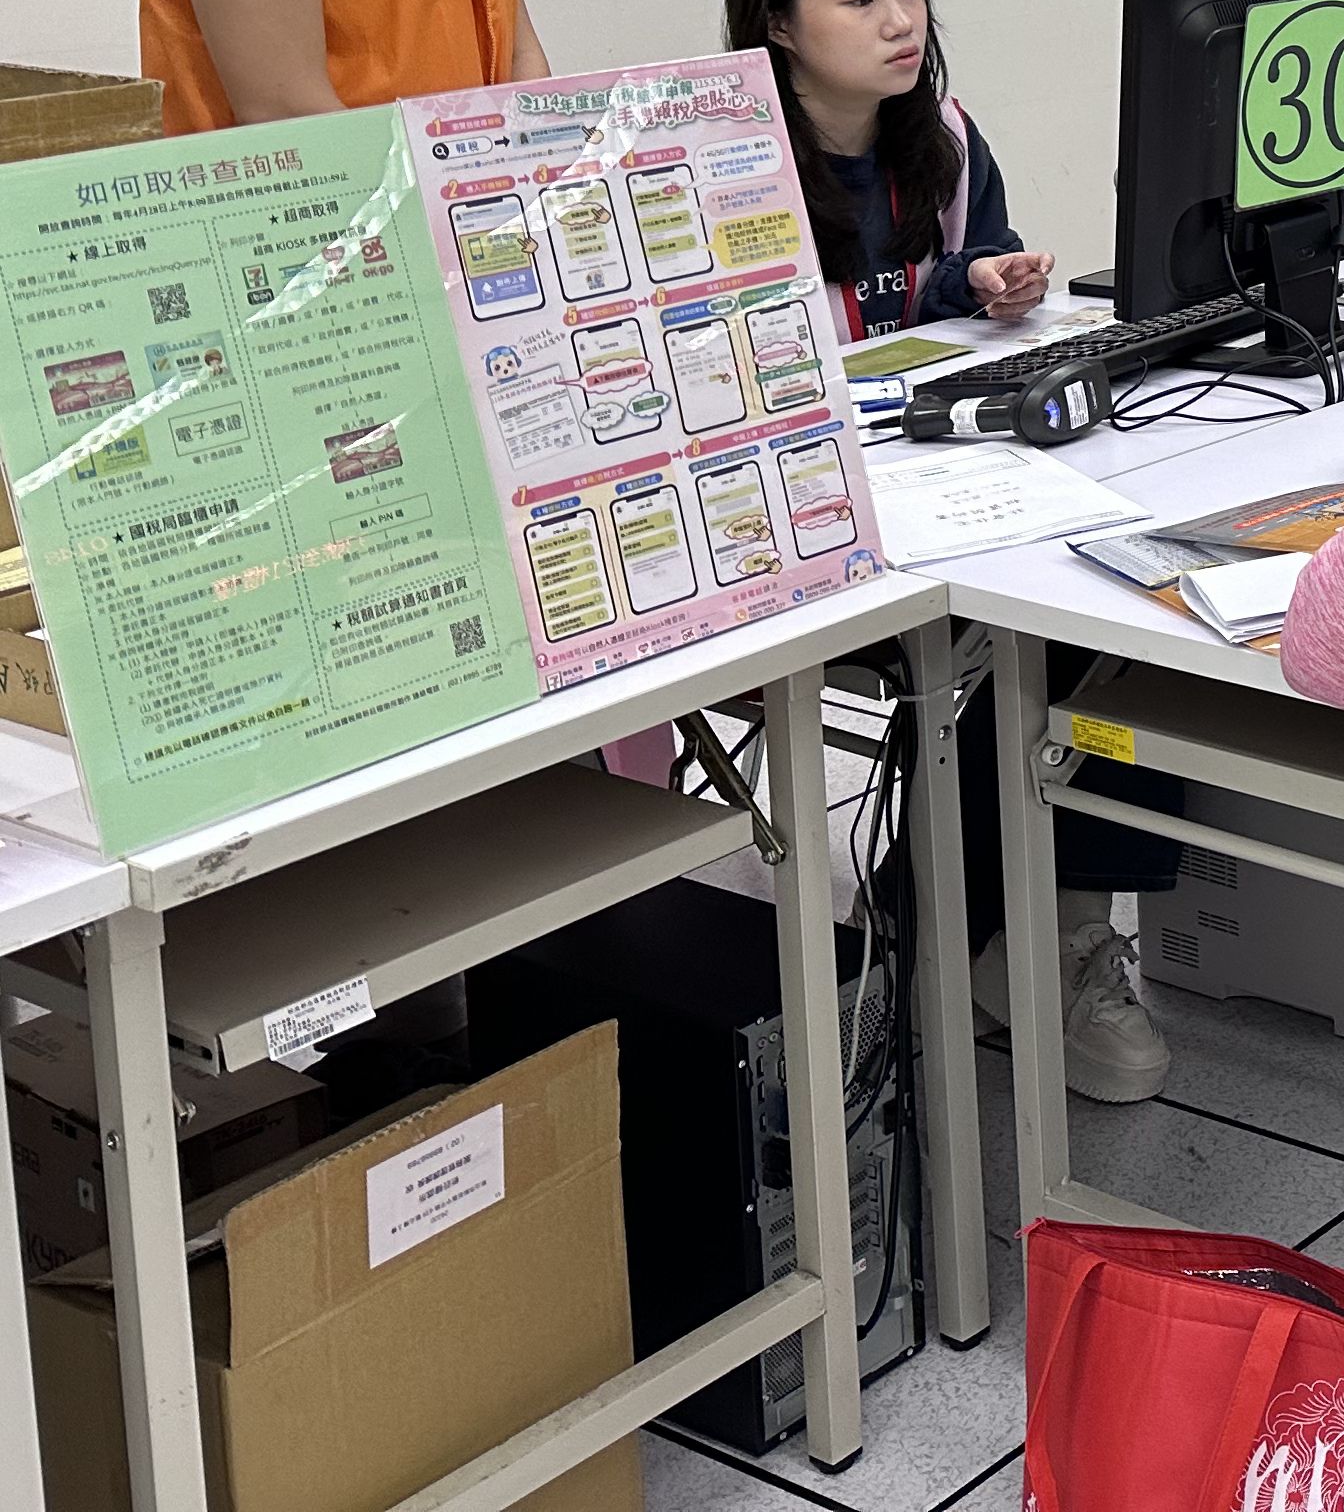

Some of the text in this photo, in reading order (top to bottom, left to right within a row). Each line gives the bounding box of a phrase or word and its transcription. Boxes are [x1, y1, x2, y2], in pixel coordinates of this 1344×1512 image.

[76, 147, 303, 208] 如何取得查詢碼
[283, 200, 339, 224] 超商取得
[84, 236, 147, 261] 線上取得
[276, 238, 308, 252] KIOSK
[78, 302, 95, 314] QR
[174, 414, 243, 445] 電子憑證
[129, 497, 240, 541] 國稅局臨櫃申請
